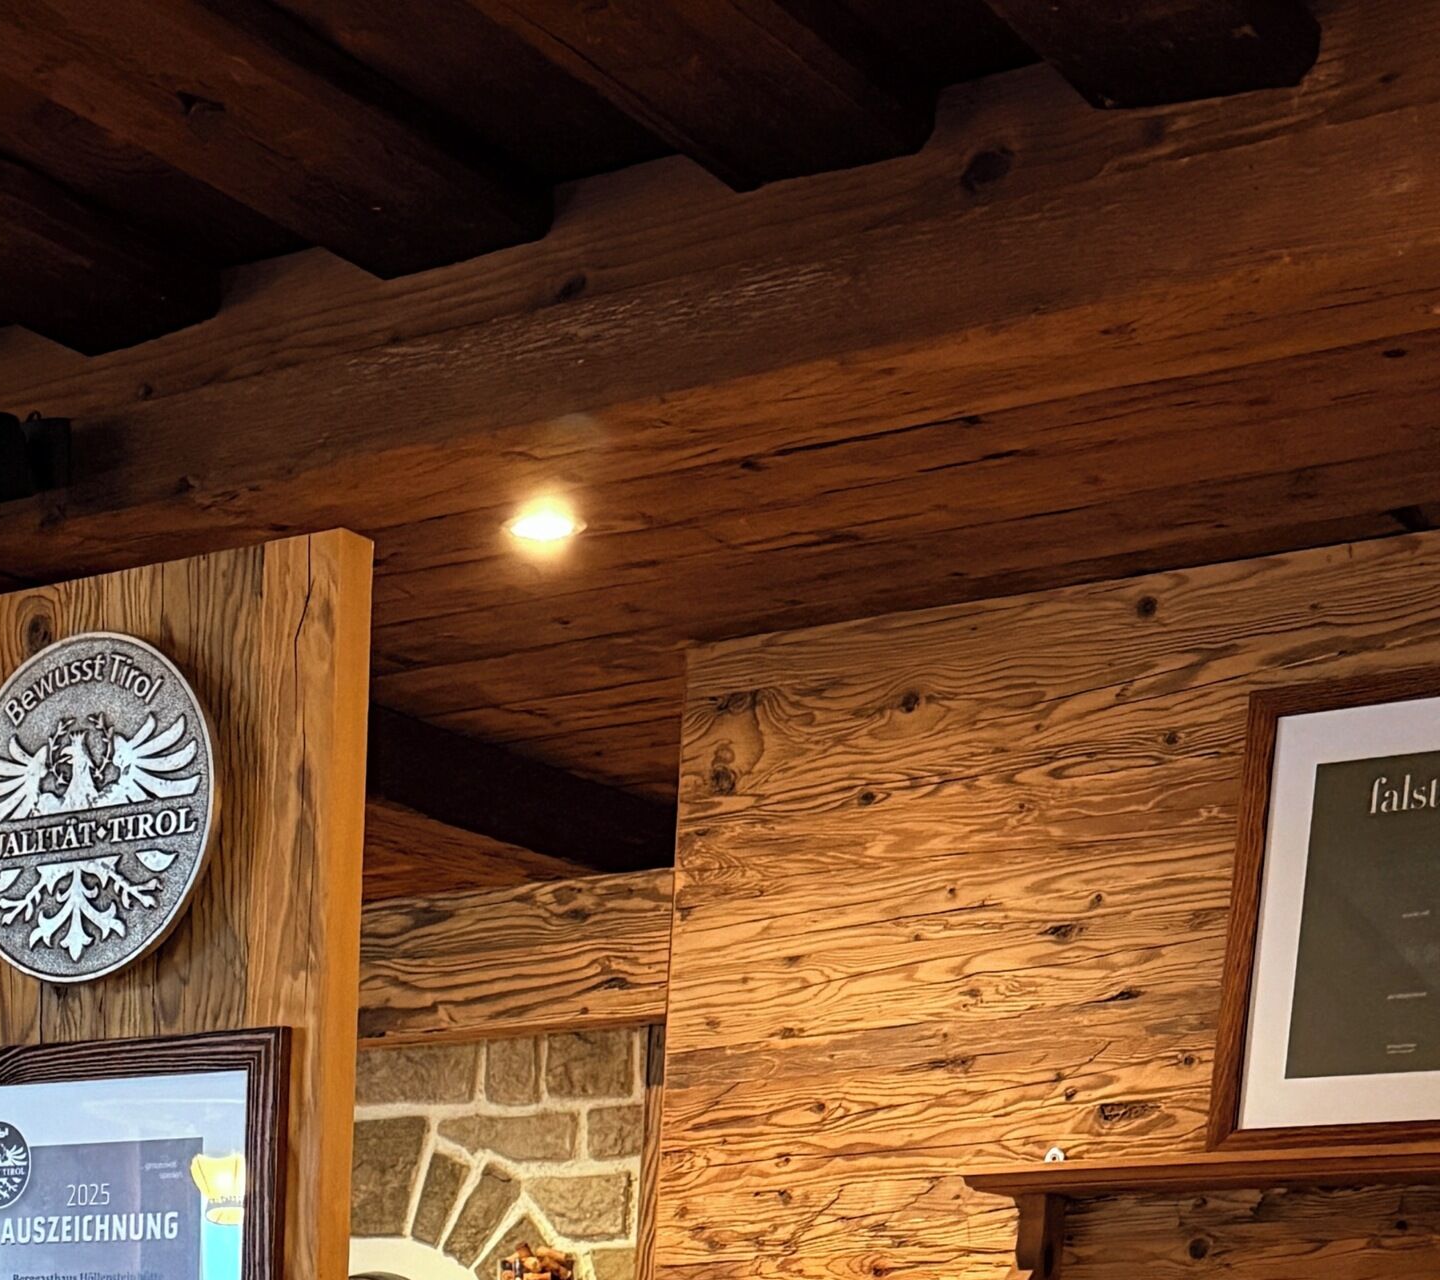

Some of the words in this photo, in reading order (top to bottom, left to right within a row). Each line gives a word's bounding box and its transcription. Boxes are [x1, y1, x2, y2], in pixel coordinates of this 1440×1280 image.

[4, 655, 105, 727] Bewusst
[109, 652, 162, 704] Tirol
[107, 807, 198, 842] TIROL
[2, 1167, 25, 1176] TIROL
[66, 1183, 110, 1206] 2025
[0, 1211, 179, 1245] AUSZEICHNUNG
